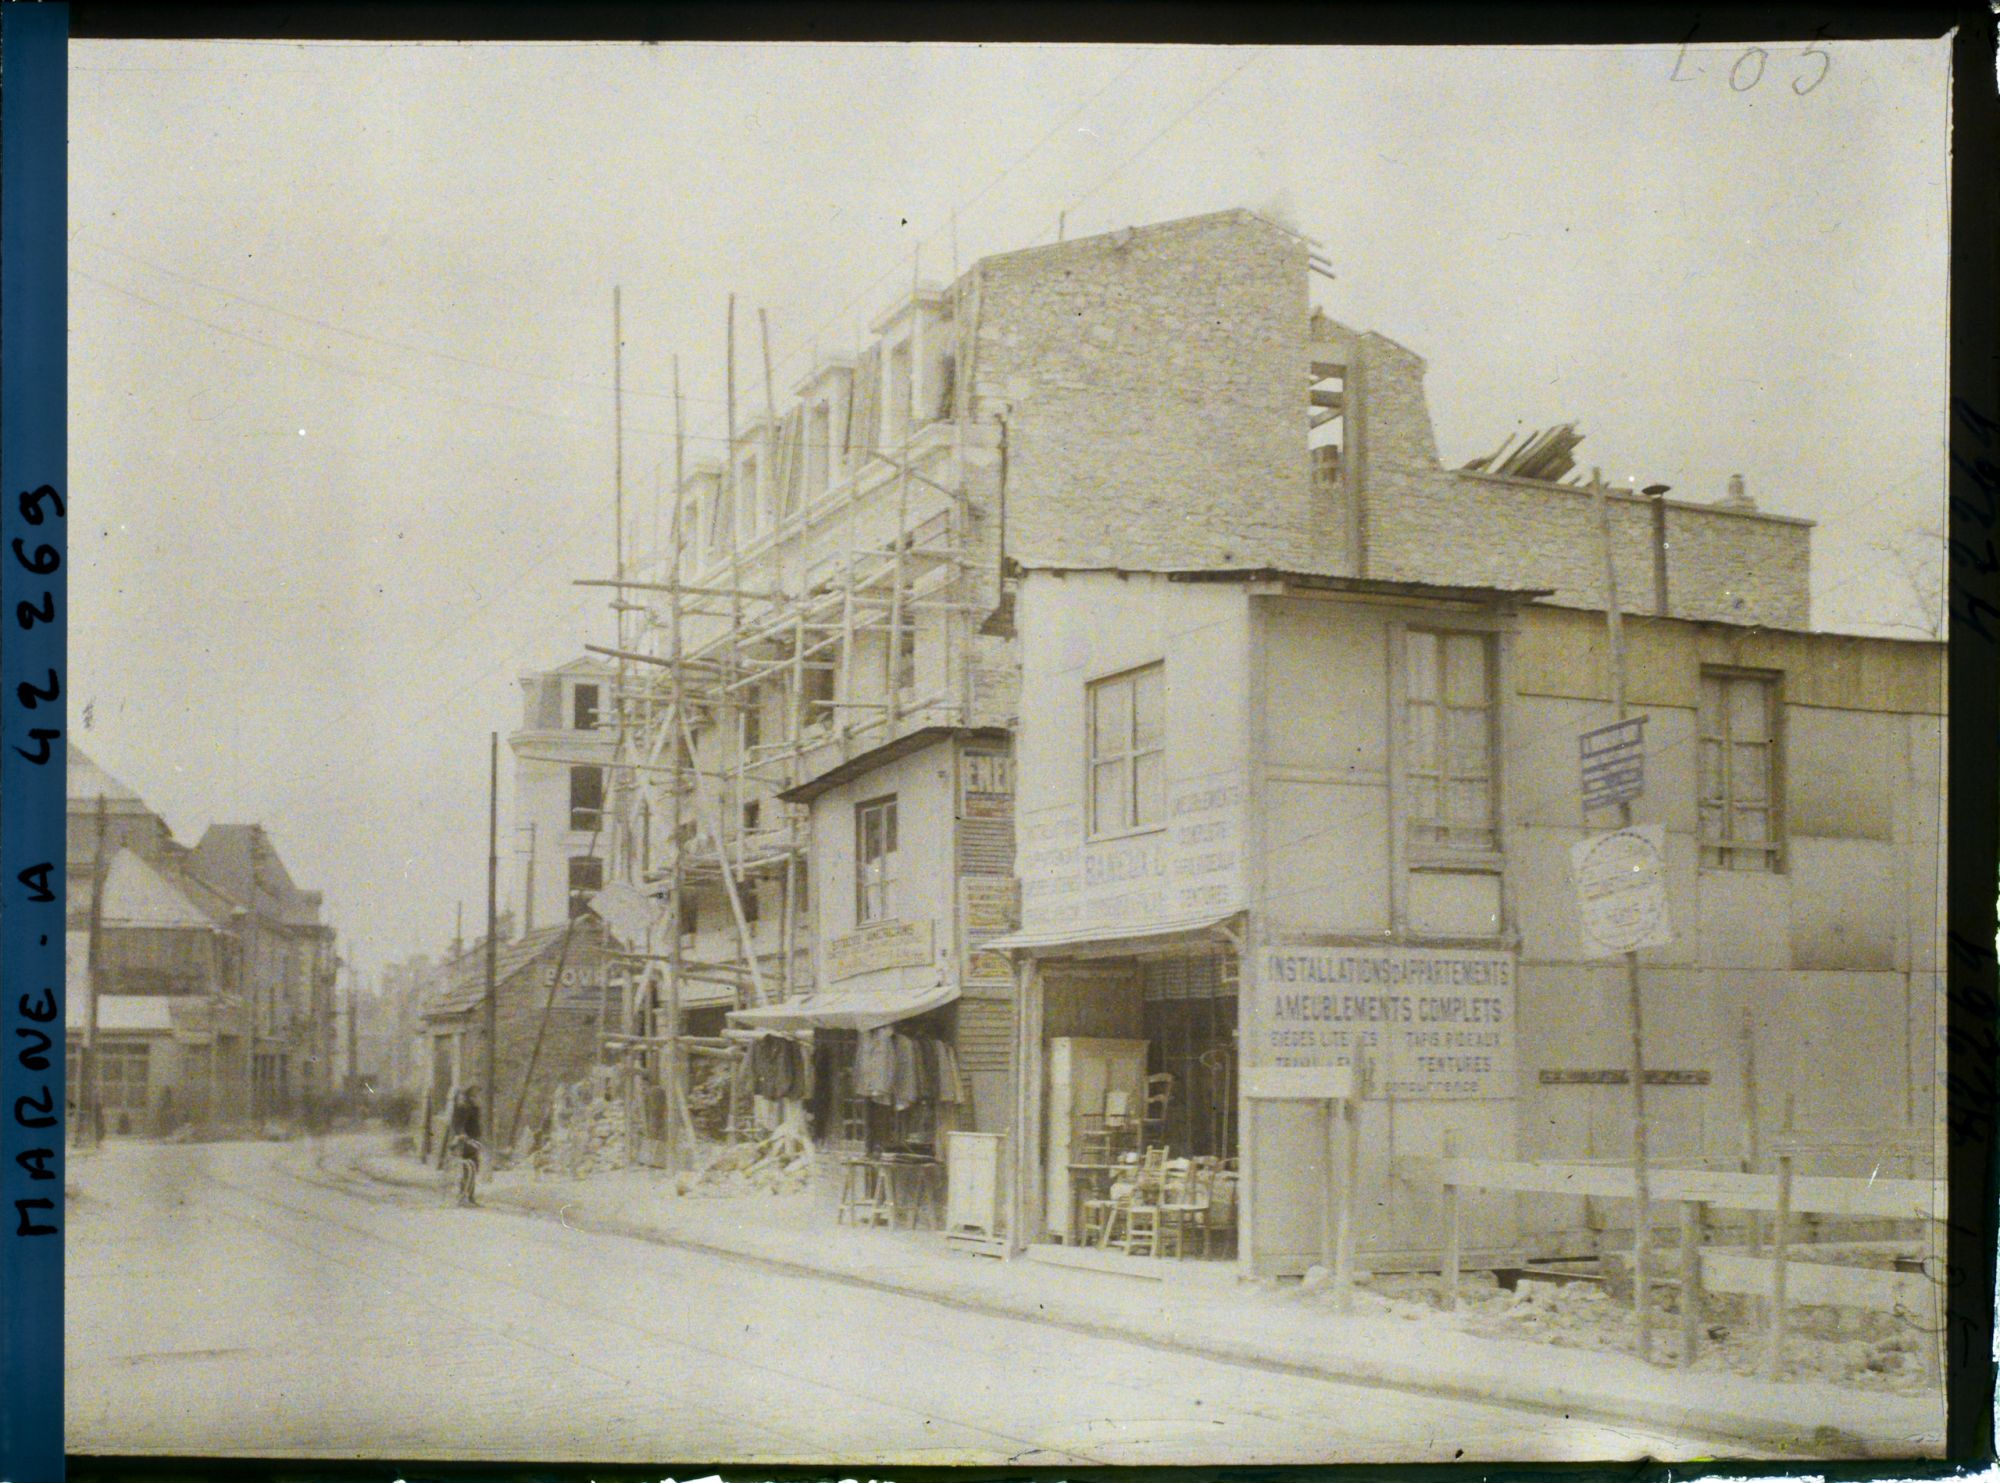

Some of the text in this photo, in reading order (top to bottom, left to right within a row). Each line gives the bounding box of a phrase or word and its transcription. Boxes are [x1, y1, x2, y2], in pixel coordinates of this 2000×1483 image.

[17, 862, 56, 903] A
[1268, 956, 1391, 983] INSTALLATIONS
[1273, 995, 1502, 1023] AMEUBLEMENTS COMPLETS
[1406, 1031, 1439, 1047] TAPIS
[1446, 1031, 1501, 1047] RIDEAUX
[1417, 1056, 1492, 1073] TENTURES
[14, 988, 59, 1237] MARNE
